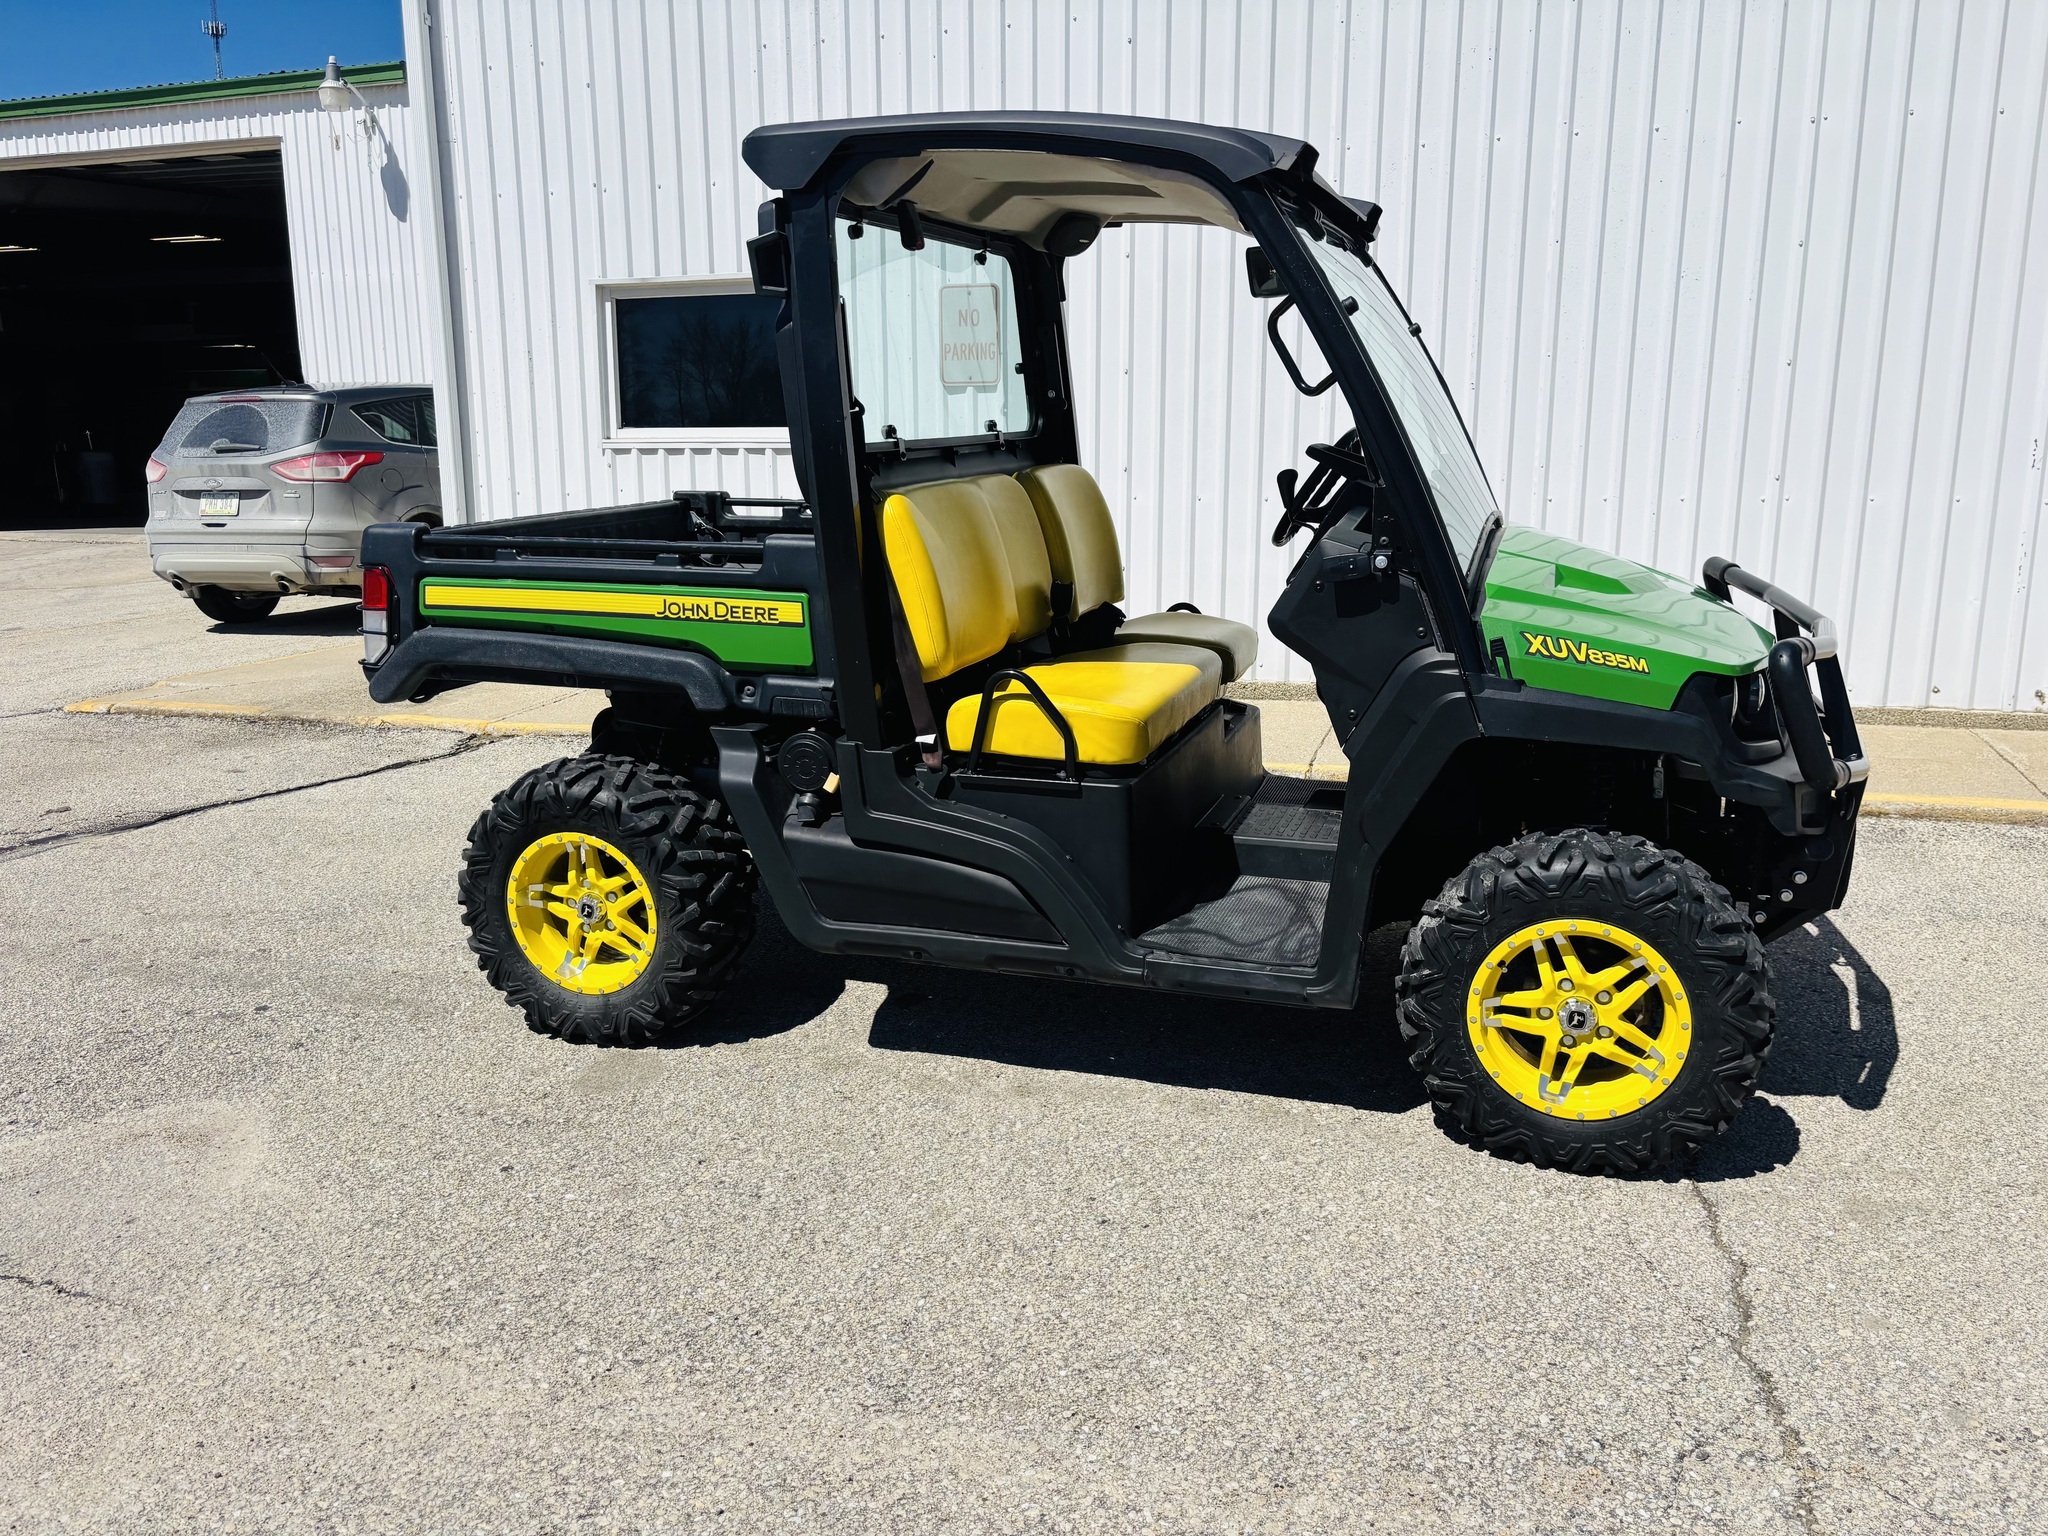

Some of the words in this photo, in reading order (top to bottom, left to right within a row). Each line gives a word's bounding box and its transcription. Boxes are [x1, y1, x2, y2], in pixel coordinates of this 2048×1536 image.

[958, 308, 981, 328] NO
[943, 342, 997, 361] PARKING
[656, 599, 709, 618] JOHN
[714, 601, 780, 622] DEERE
[1520, 631, 1650, 675] XUV835M
